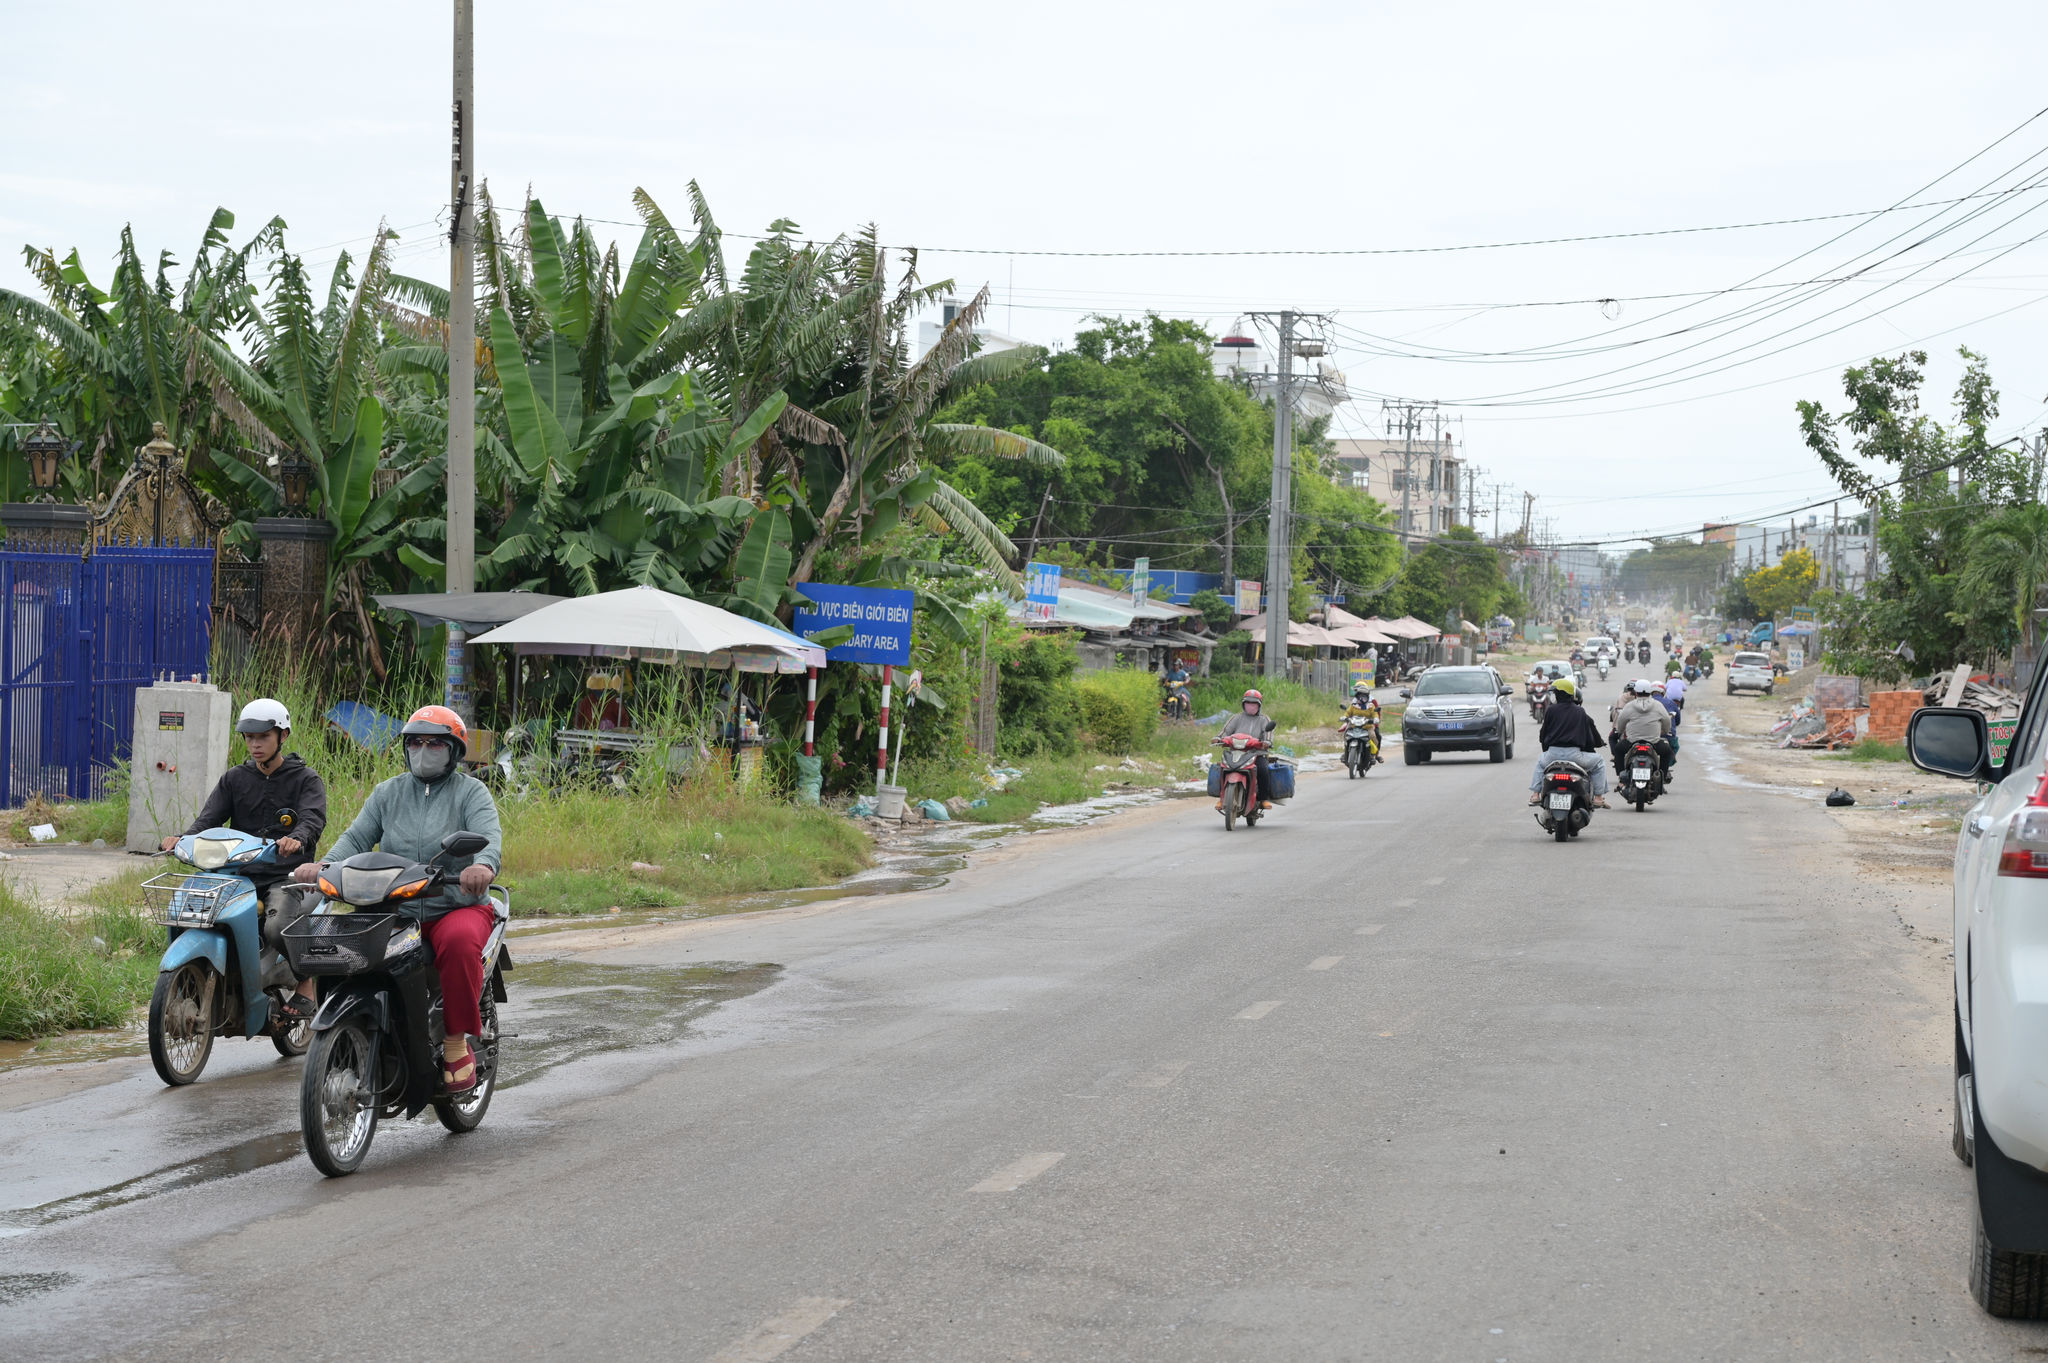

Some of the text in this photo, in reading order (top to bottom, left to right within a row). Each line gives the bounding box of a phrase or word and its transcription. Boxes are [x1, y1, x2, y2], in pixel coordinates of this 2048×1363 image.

[821, 601, 841, 620] VỰC
[865, 602, 886, 621] GIỚI
[873, 635, 899, 651] AREA
[1994, 723, 2008, 740] TÓC
